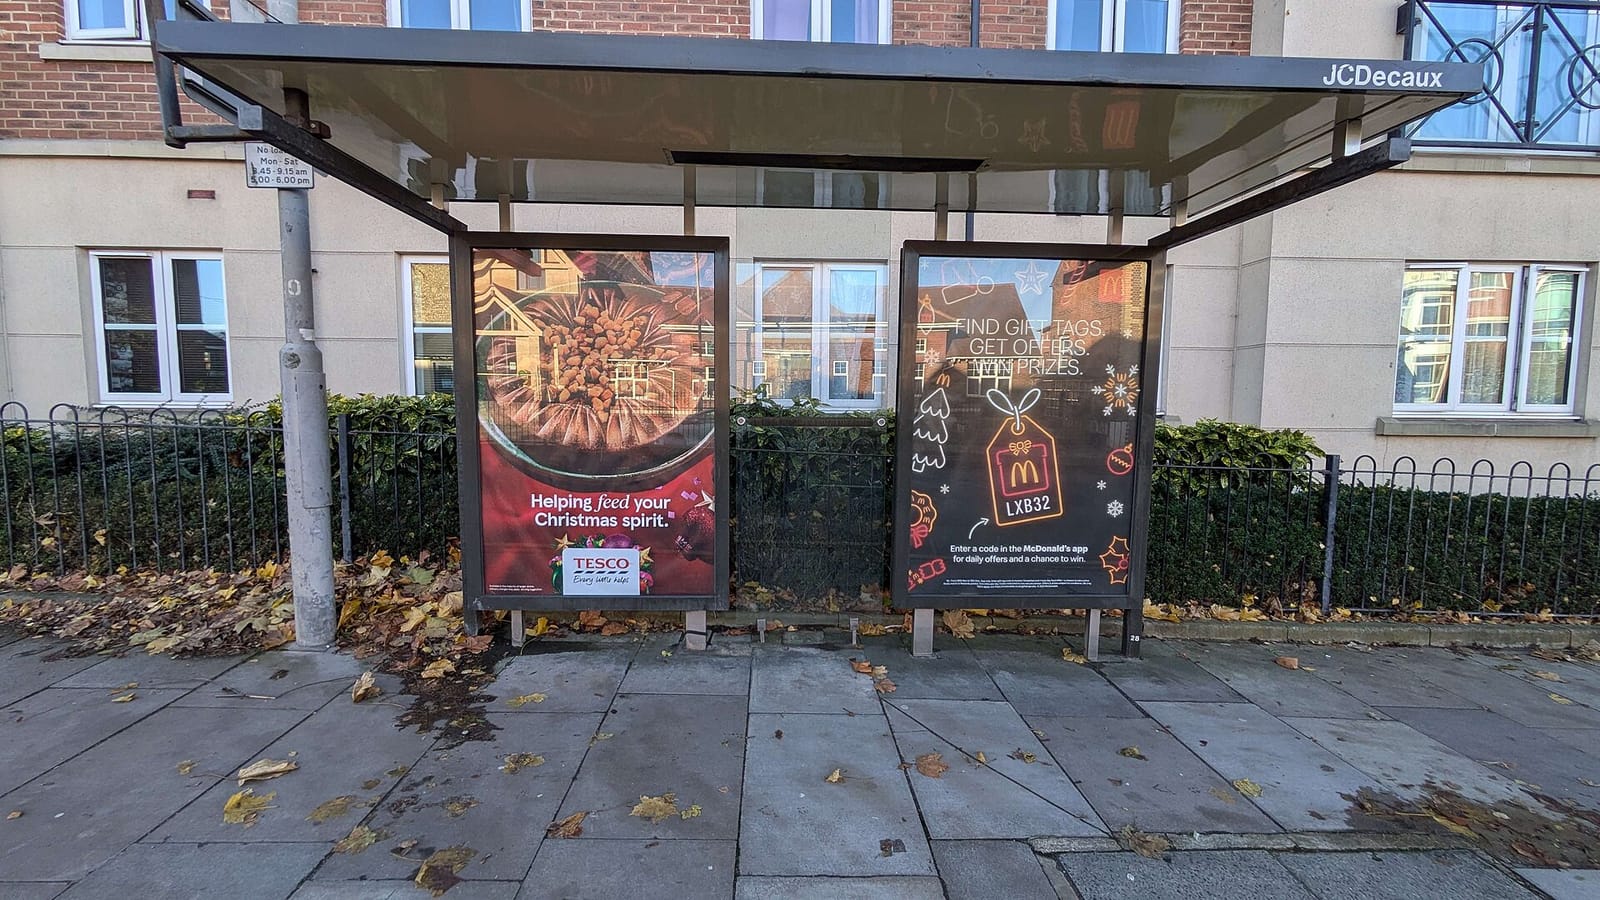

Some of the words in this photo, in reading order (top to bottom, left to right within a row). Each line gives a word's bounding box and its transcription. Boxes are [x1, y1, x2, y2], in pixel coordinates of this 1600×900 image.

[1322, 63, 1443, 88] JCDecaux
[256, 146, 269, 154] No
[260, 157, 278, 165] Mon
[284, 157, 299, 165] Sat
[955, 318, 1000, 335] FIND
[1005, 318, 1045, 336] GIFT
[1053, 319, 1106, 337] TAGS.
[969, 337, 1009, 355] GET
[1013, 337, 1090, 356] OFFERS.
[974, 359, 1012, 375] WIN
[1017, 359, 1084, 376] PRIZES.
[530, 493, 593, 511] Helping
[593, 493, 631, 513] feed
[633, 498, 671, 513] your
[1006, 495, 1051, 517] LXB32
[534, 512, 618, 527] Christmas
[622, 512, 669, 531] spirit.
[950, 544, 971, 553] Enter
[978, 544, 999, 553] code
[1000, 544, 1008, 553] in
[1008, 544, 1022, 553] the
[1071, 546, 1089, 554] app
[573, 557, 629, 569] TESCO
[953, 554, 965, 563] for
[965, 554, 984, 565] daily
[984, 554, 1008, 563] offers
[1008, 554, 1024, 563] and
[1030, 554, 1059, 563] chance
[1060, 555, 1069, 563] to
[1069, 554, 1087, 563] win.
[572, 575, 594, 586] Every
[1129, 634, 1140, 642] 28
